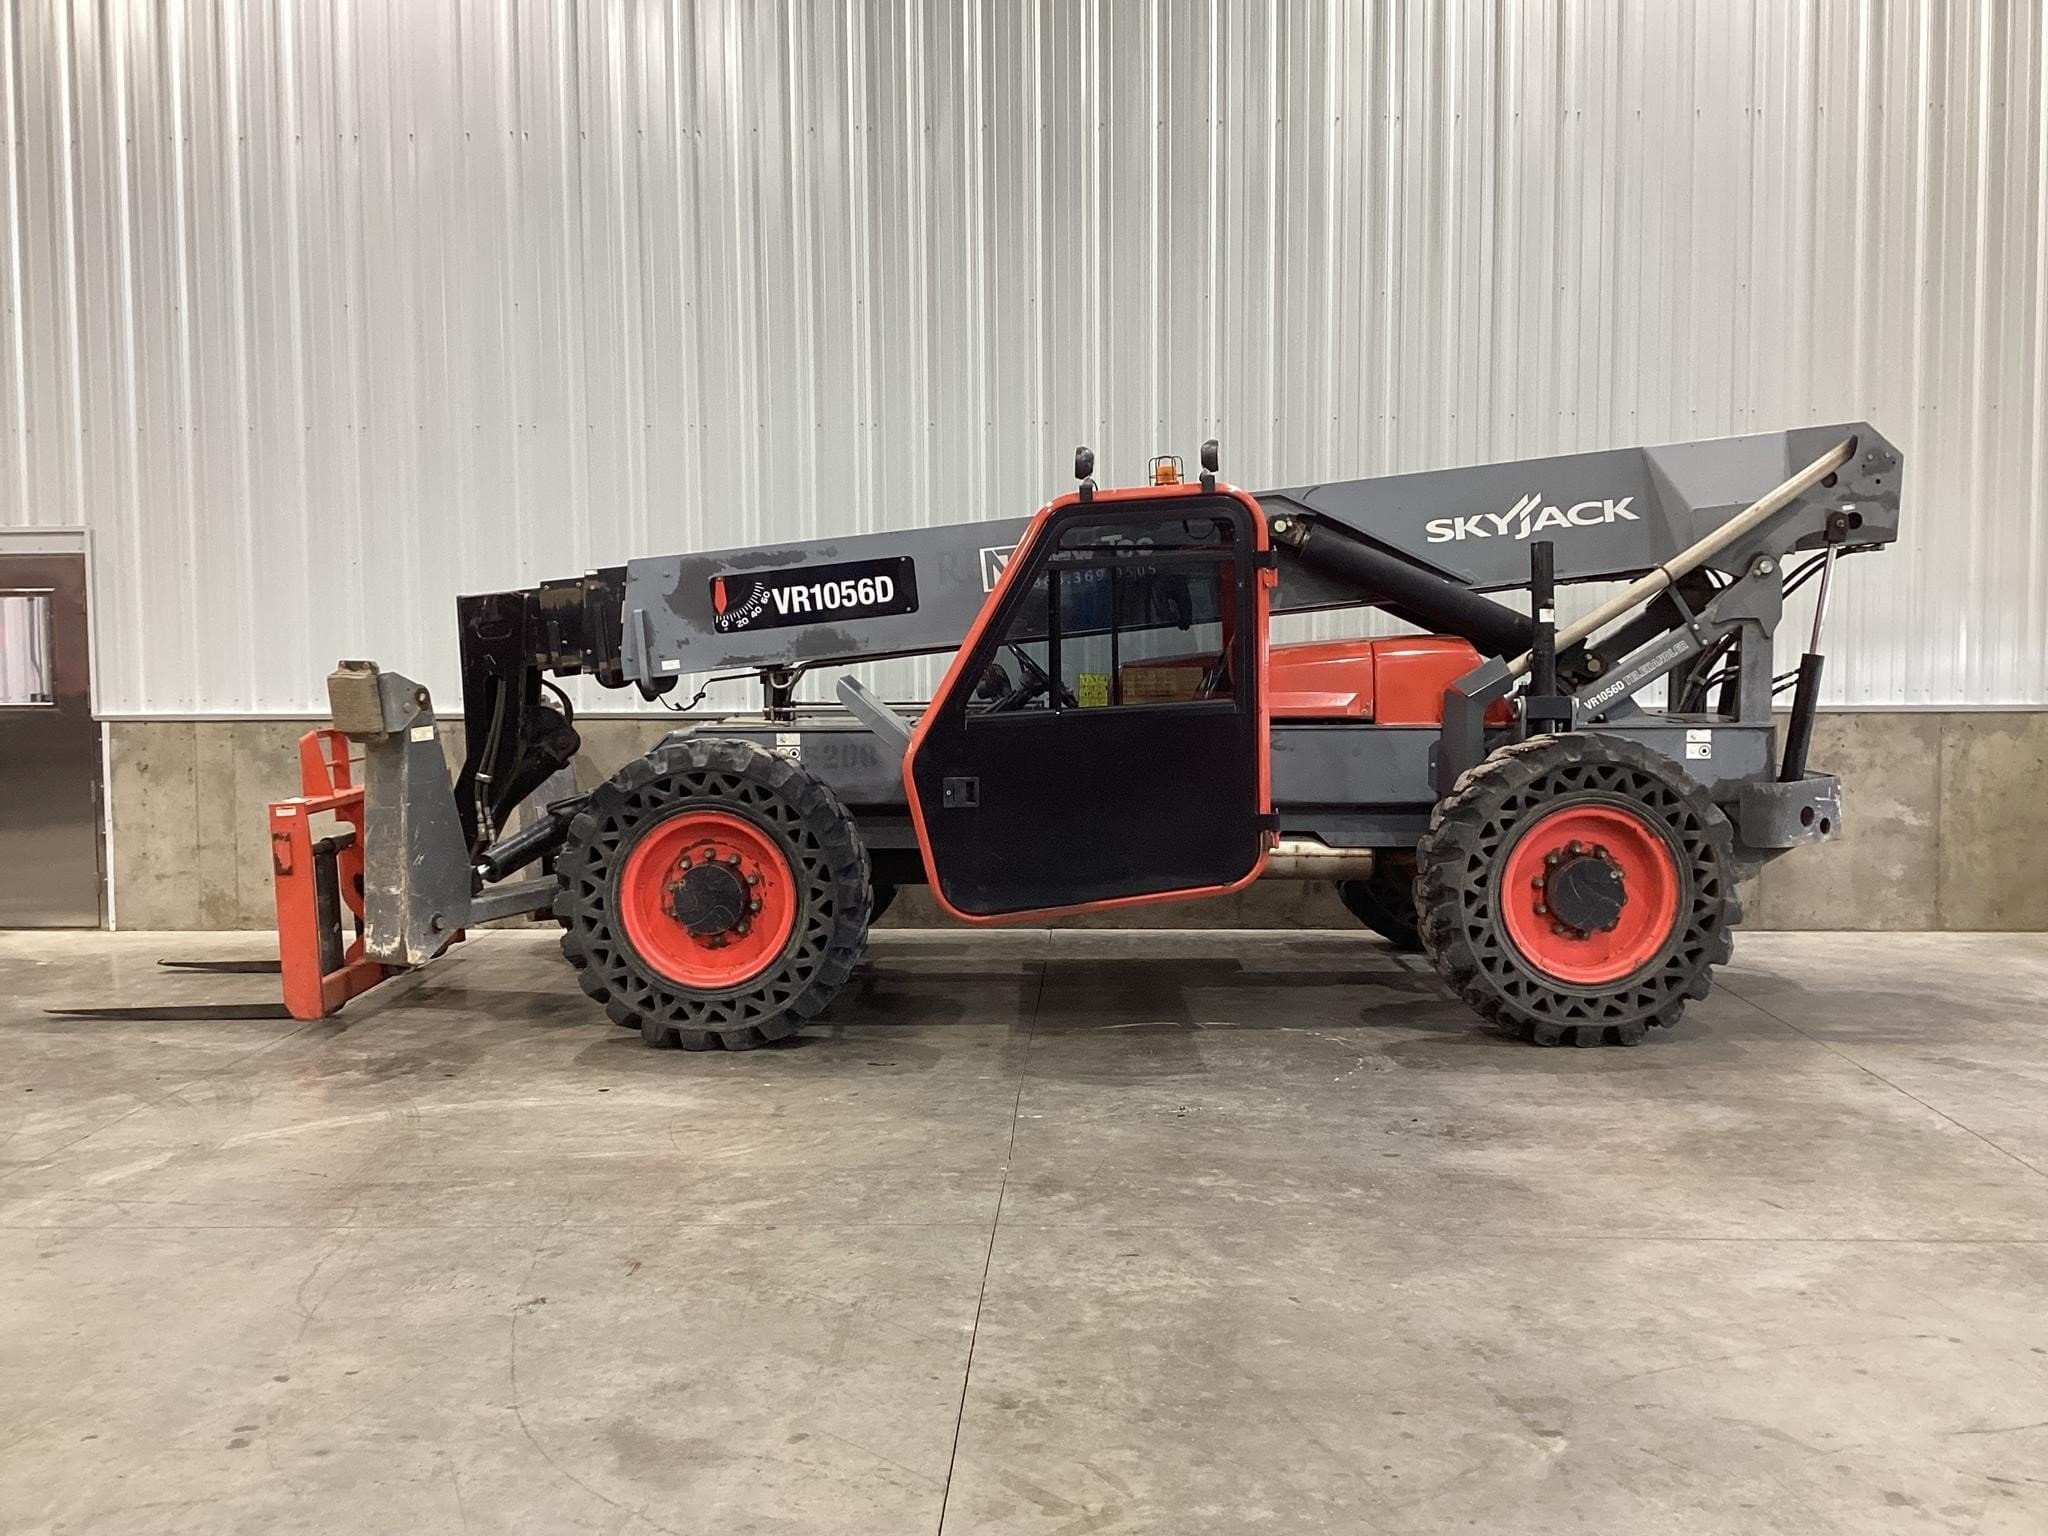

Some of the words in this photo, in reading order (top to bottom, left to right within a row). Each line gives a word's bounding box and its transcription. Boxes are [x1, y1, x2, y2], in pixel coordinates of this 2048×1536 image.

[1425, 492, 1640, 543] SKYJACK
[771, 575, 893, 615] VR1056D
[751, 606, 762, 618] 40
[721, 619, 729, 628] 0
[736, 617, 749, 628] 20
[1583, 681, 1624, 710] VR1056D
